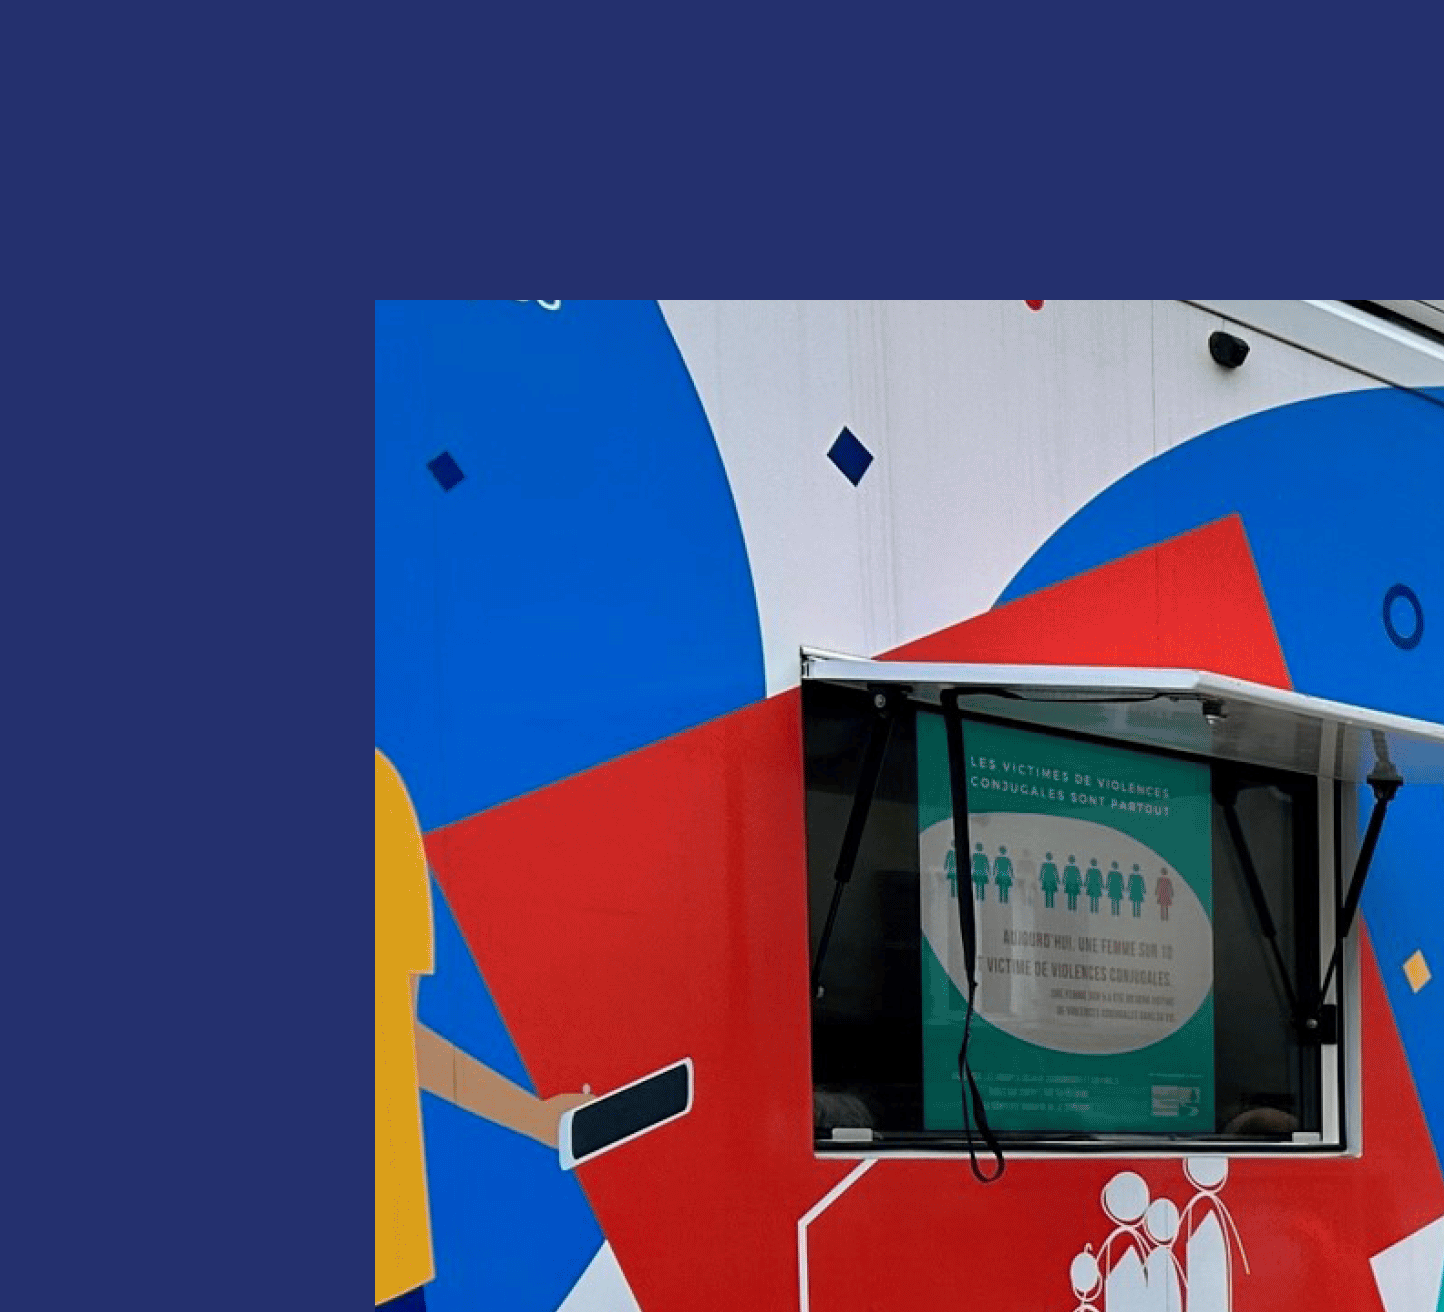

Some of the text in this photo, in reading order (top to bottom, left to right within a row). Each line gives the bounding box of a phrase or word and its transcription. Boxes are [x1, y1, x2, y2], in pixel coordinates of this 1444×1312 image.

[971, 756, 1169, 799] LES VICTIMES DE VIOLENCES
[971, 776, 1169, 816] CONJUGALES SONT PARTOUT
[987, 957, 1031, 976] VICTIME
[1034, 960, 1048, 977] DE
[1051, 962, 1106, 981] VIOLENCES
